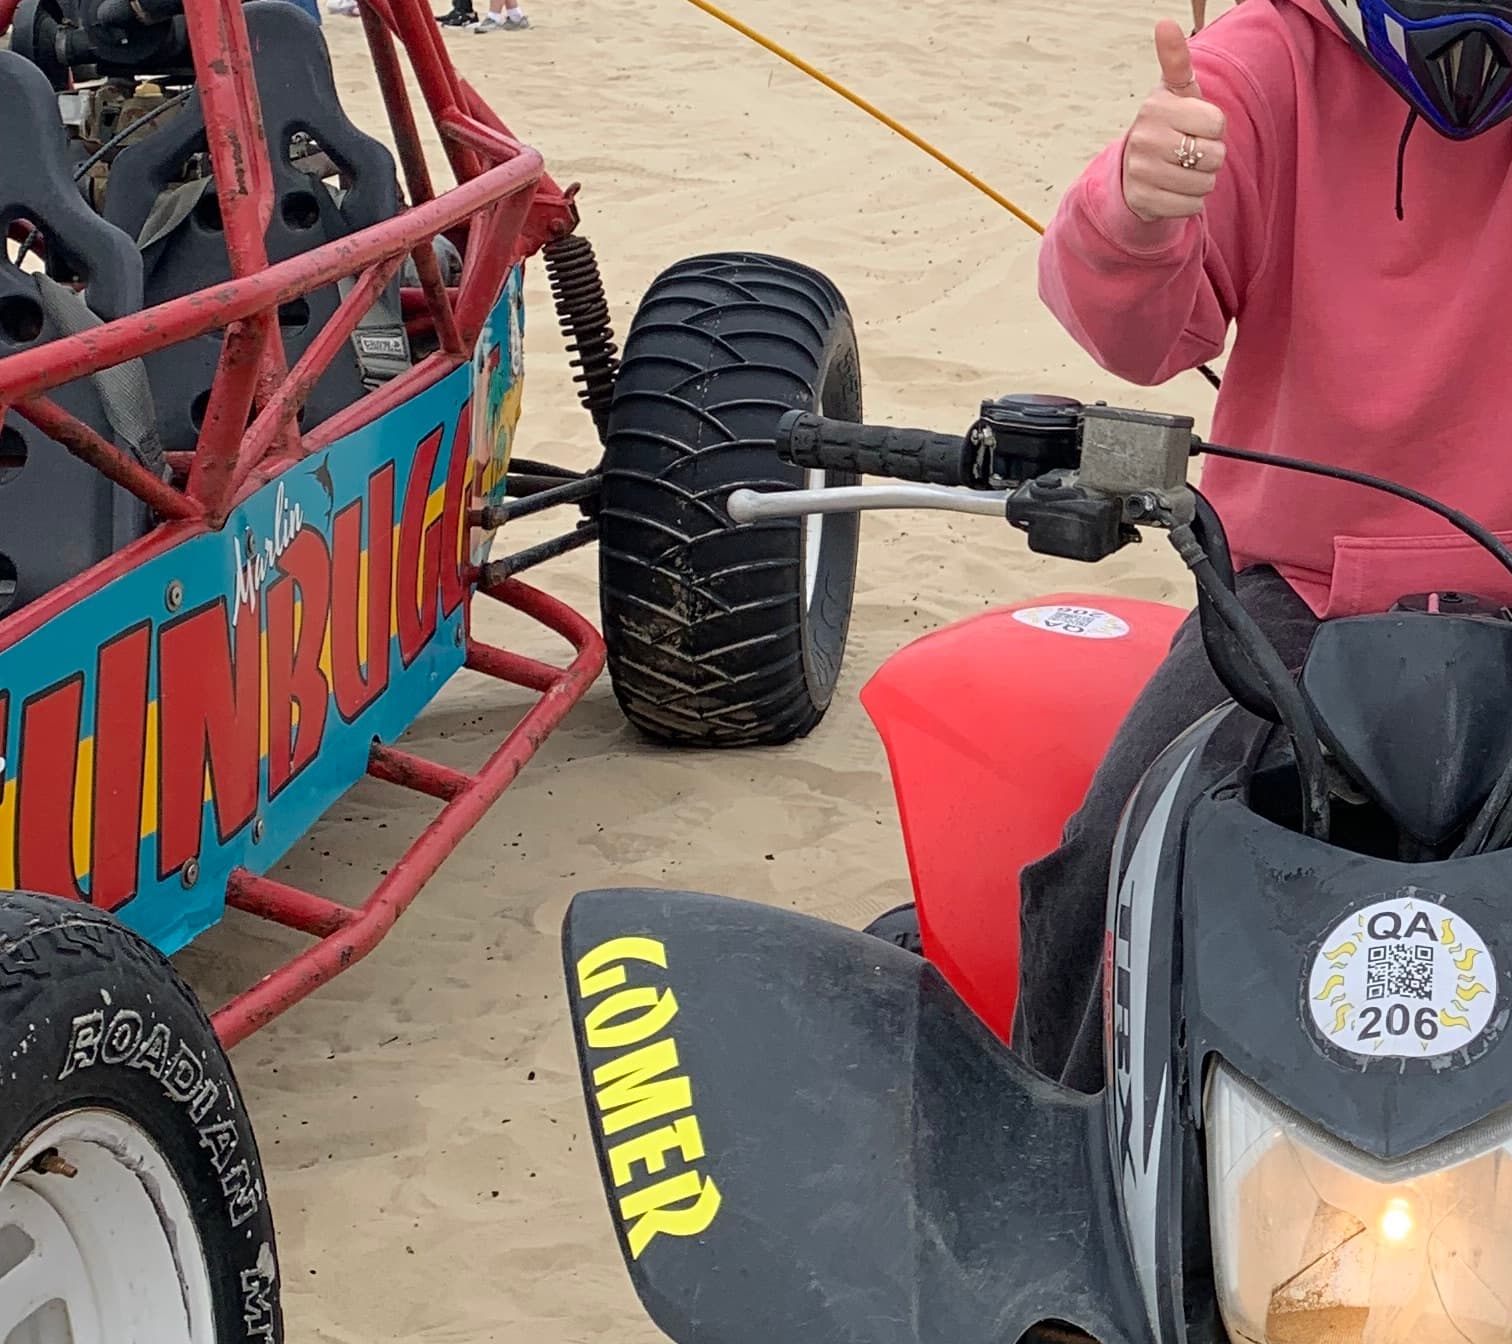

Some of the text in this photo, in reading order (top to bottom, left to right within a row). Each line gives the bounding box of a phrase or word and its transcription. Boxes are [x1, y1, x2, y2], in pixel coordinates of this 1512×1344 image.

[232, 480, 304, 627] Marlin
[1367, 911, 1439, 942] QA
[1357, 1003, 1439, 1041] 206
[59, 1009, 260, 1227] ROADIAN
[576, 937, 722, 1260] GOMER
